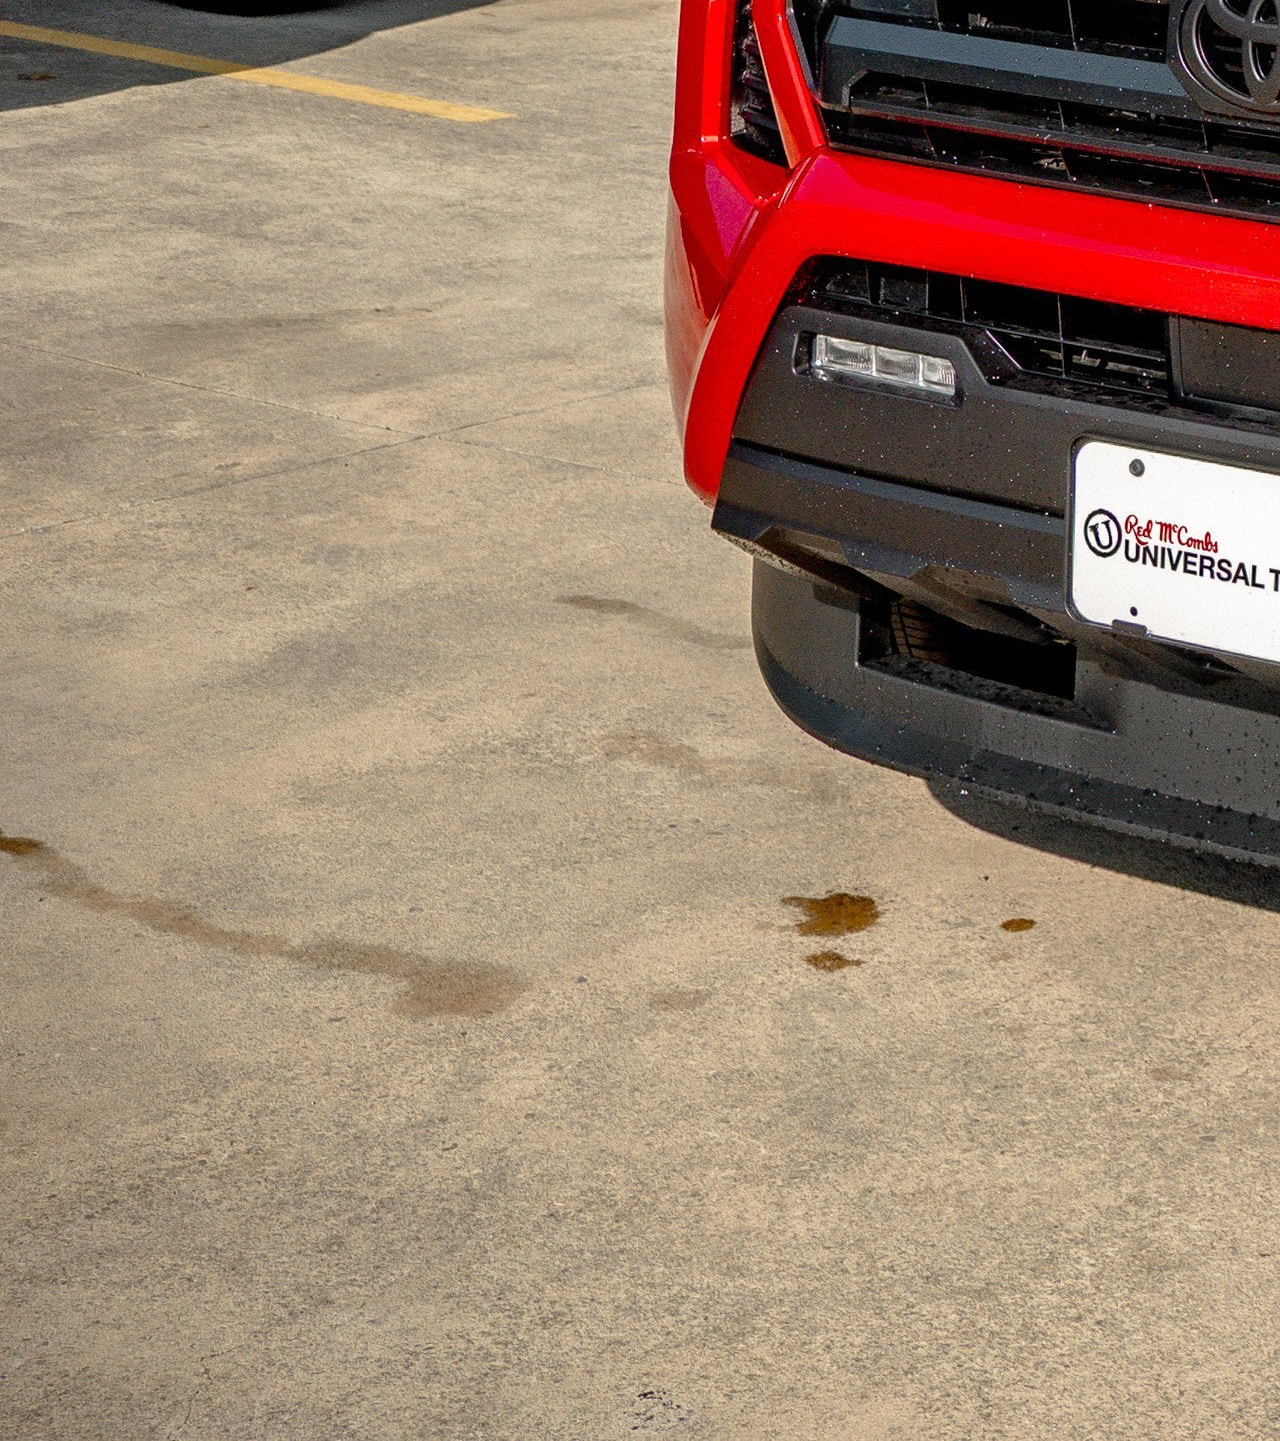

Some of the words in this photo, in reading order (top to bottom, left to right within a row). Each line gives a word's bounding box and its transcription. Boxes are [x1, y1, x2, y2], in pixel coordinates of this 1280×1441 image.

[1125, 514, 1153, 546] Red
[1155, 521, 1219, 554] McCombs
[1124, 539, 1265, 589] UNIVERSAL
